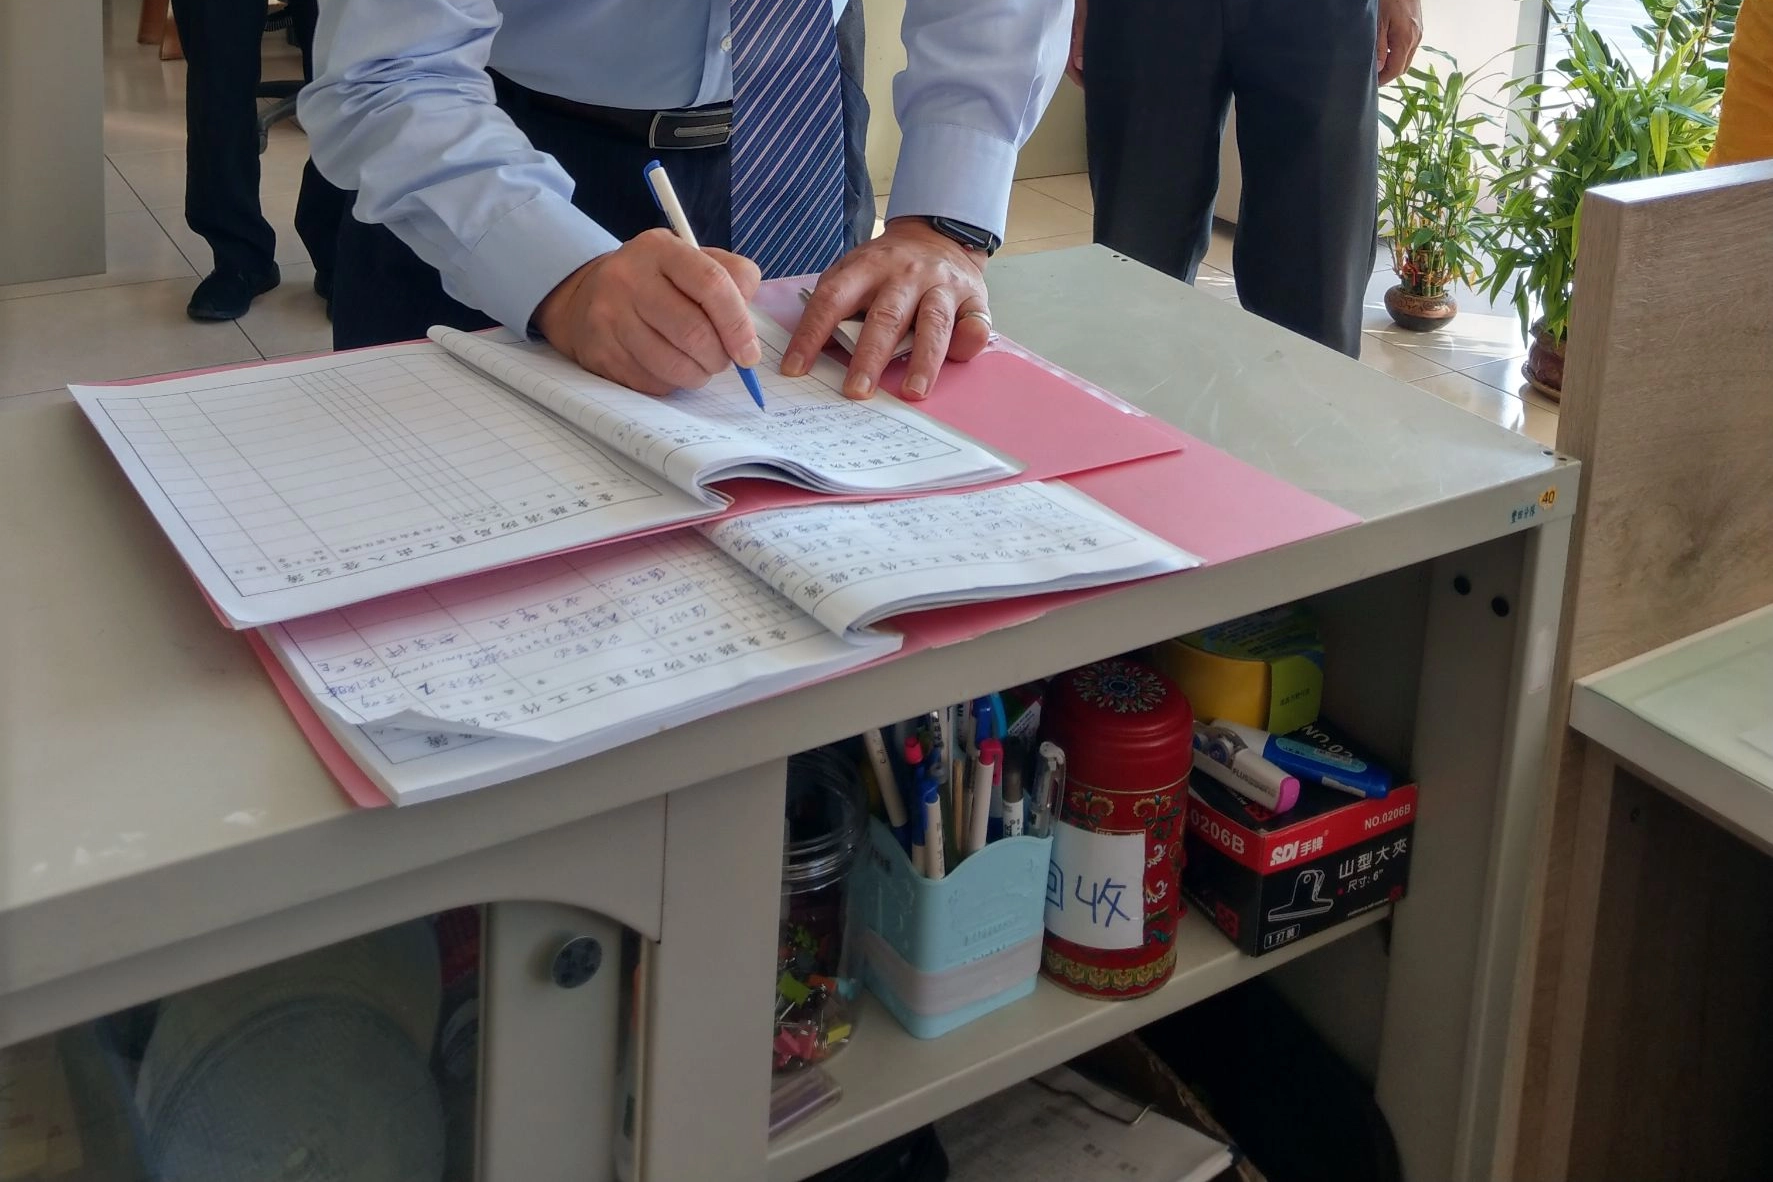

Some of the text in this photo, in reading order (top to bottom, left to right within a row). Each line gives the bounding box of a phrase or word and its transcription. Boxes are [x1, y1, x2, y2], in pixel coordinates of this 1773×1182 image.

[1541, 489, 1556, 505] 40
[1364, 803, 1411, 830] NO.0206B
[1269, 835, 1324, 866] SDI 手牌
[1339, 837, 1408, 879] 山型大夾
